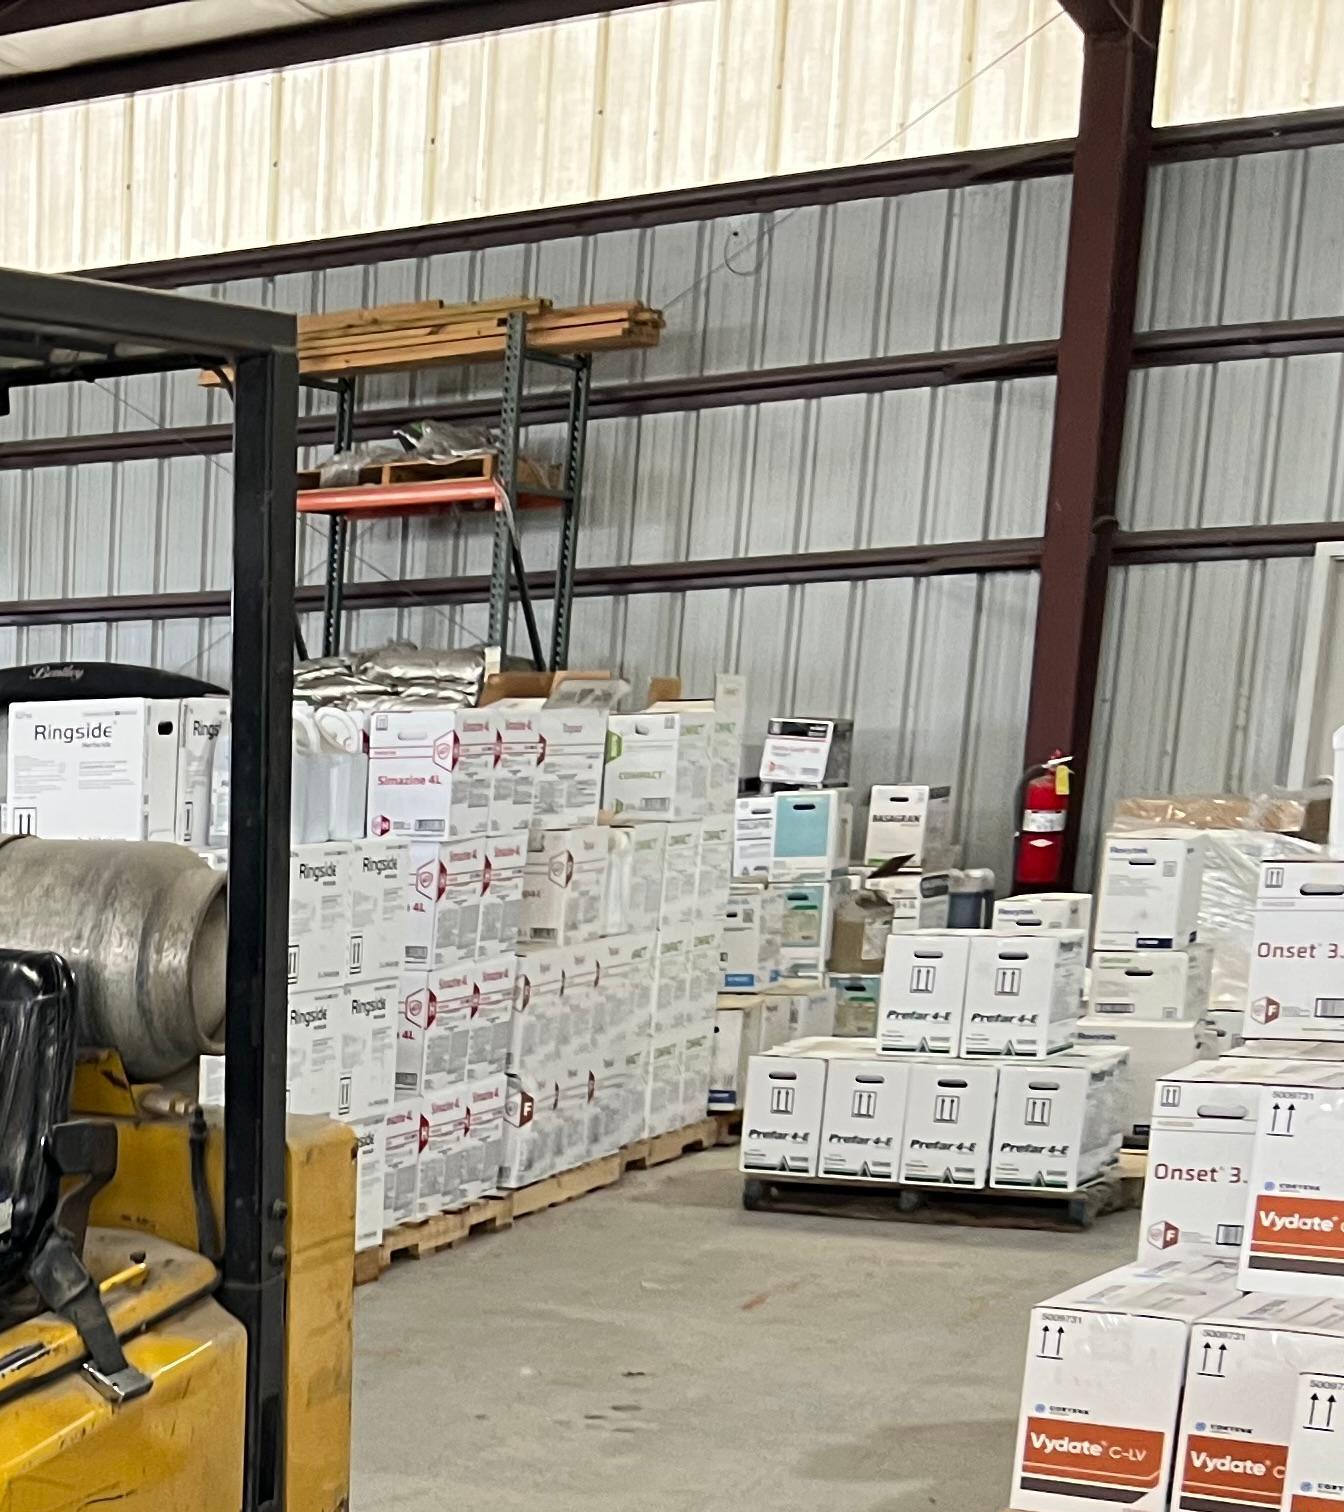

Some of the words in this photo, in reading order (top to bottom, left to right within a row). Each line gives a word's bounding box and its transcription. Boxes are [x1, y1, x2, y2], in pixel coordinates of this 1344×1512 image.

[34, 723, 112, 743] Ringside
[377, 775, 425, 786] Simazine
[428, 774, 442, 784] 4L
[1257, 942, 1316, 958] Onset
[886, 1010, 928, 1021] Prefar
[971, 1012, 1014, 1023] Prefar
[523, 1102, 533, 1116] F
[1154, 1163, 1218, 1183] Onset
[1259, 1211, 1335, 1232] Vydate
[1030, 1431, 1103, 1457] Vydate
[1108, 1446, 1147, 1461] C-LV
[1190, 1450, 1266, 1476] Vydate
